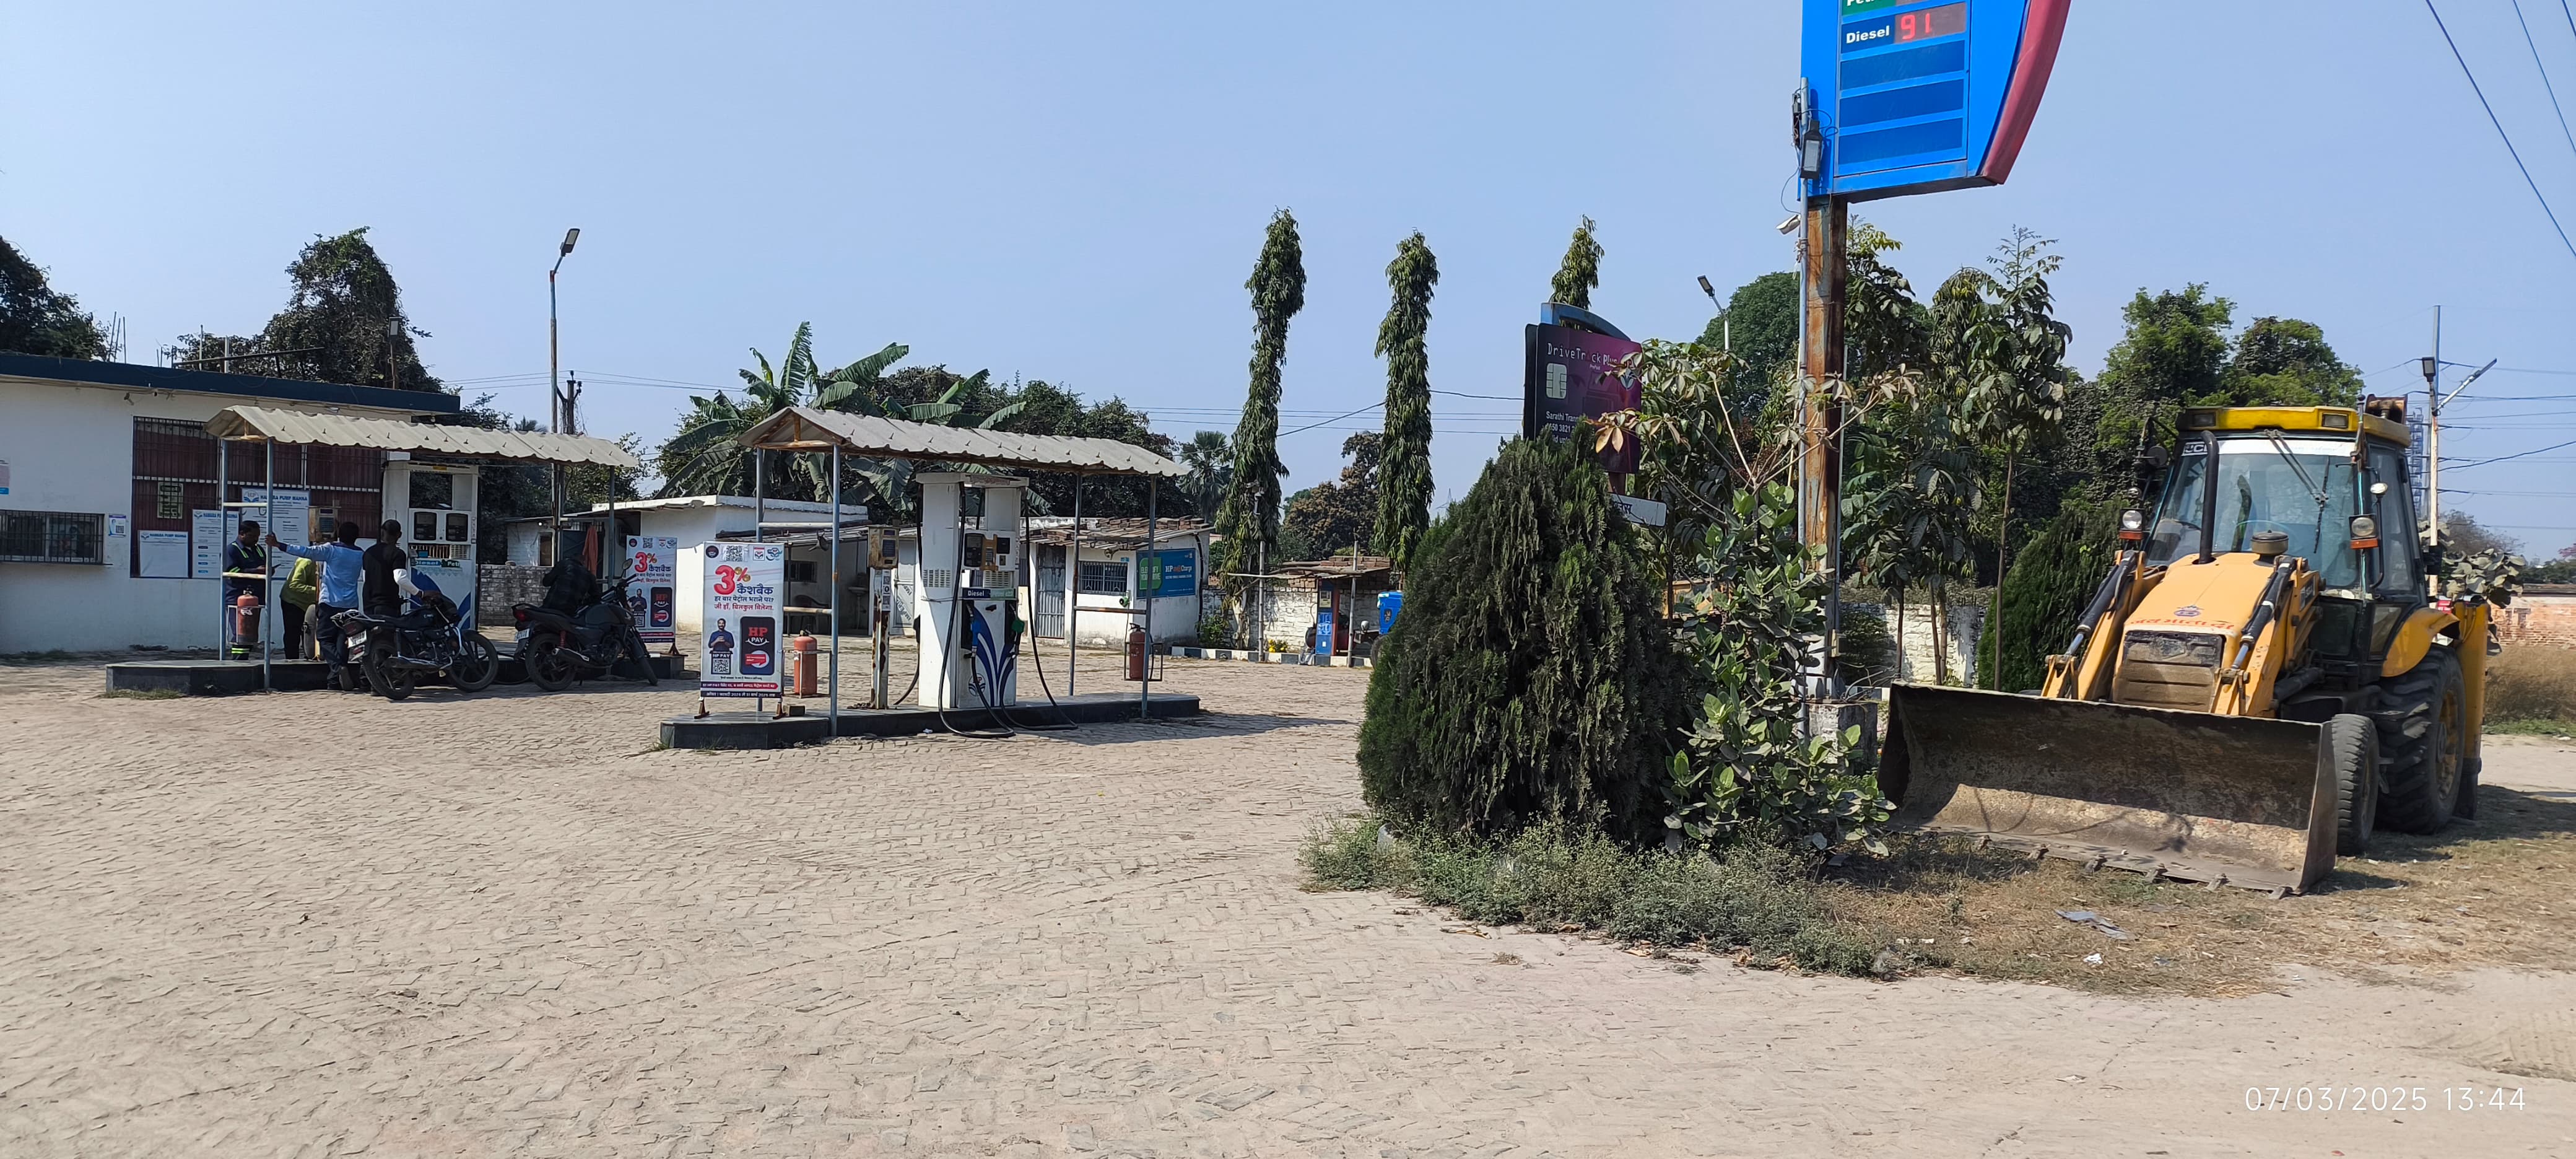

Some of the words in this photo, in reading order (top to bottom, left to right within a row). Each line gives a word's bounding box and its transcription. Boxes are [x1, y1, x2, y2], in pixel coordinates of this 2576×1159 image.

[1846, 25, 1890, 43] Diesel
[1900, 12, 1931, 40] 91
[1546, 411, 1564, 421] Sarathi
[635, 551, 657, 572] 3%
[713, 564, 751, 595] 3%
[736, 582, 774, 595] कैशबैक
[733, 595, 747, 603] पेट्रोल
[733, 602, 754, 611] बिलकुल
[748, 627, 768, 636] HP
